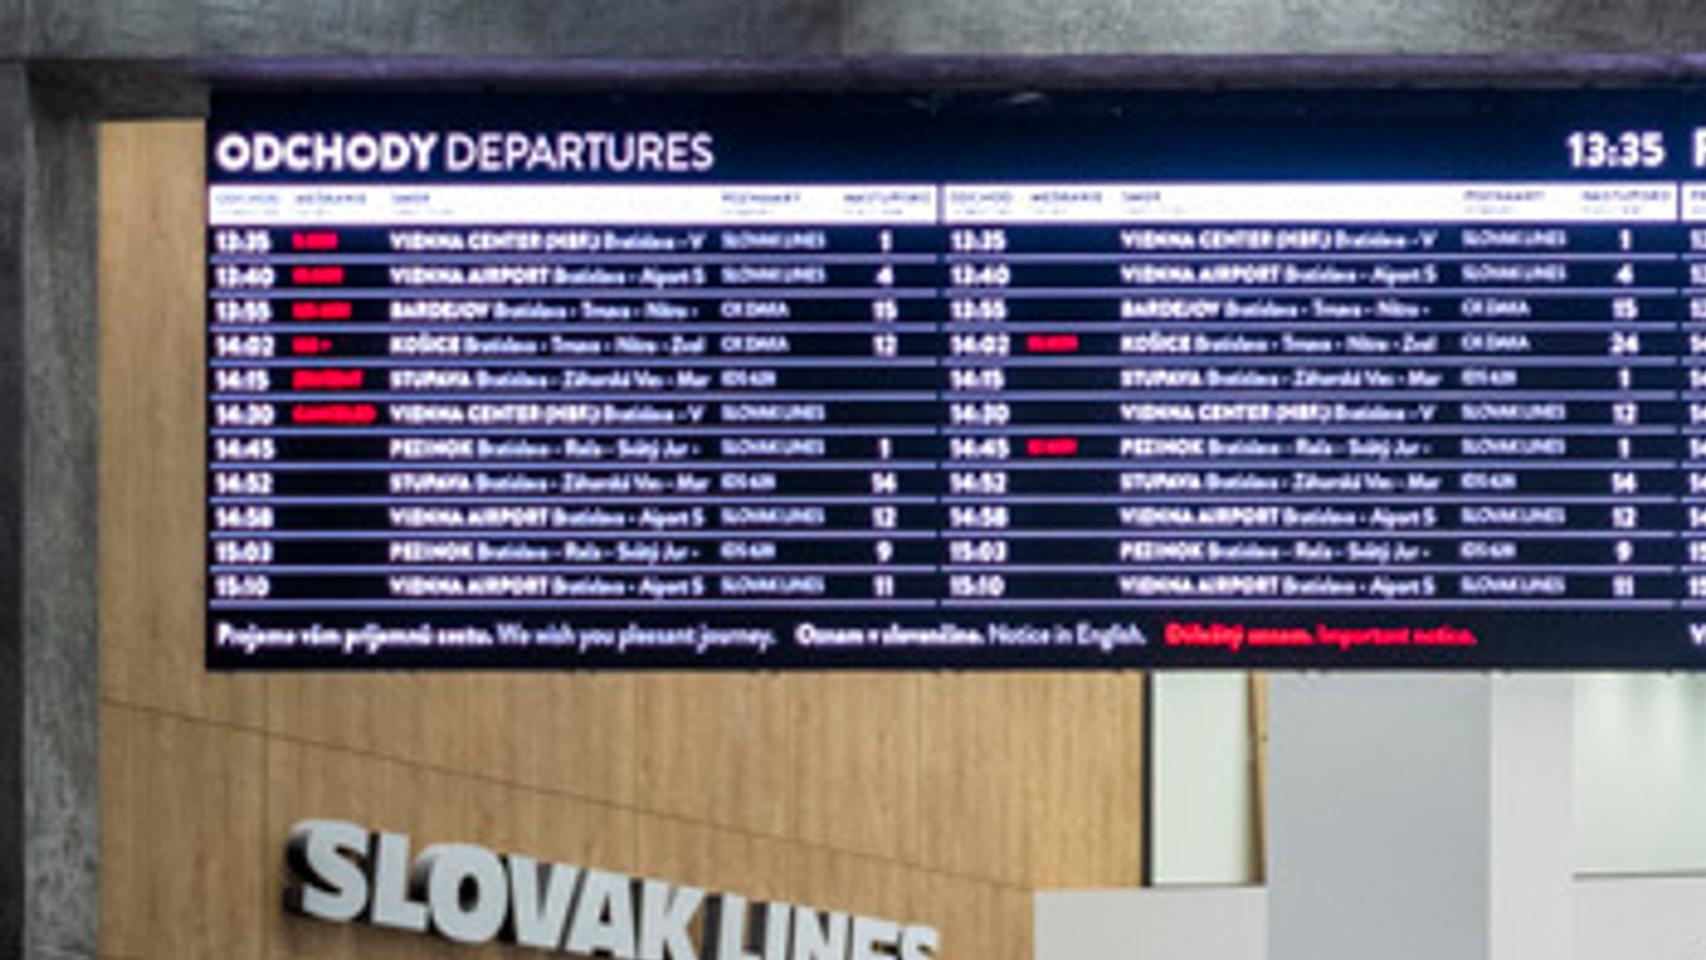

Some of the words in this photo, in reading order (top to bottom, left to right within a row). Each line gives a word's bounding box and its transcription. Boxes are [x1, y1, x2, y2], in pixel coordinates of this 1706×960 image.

[216, 133, 438, 171] ODCHODY
[447, 133, 713, 171] DEPARTURES
[1568, 131, 1665, 168] 13:35
